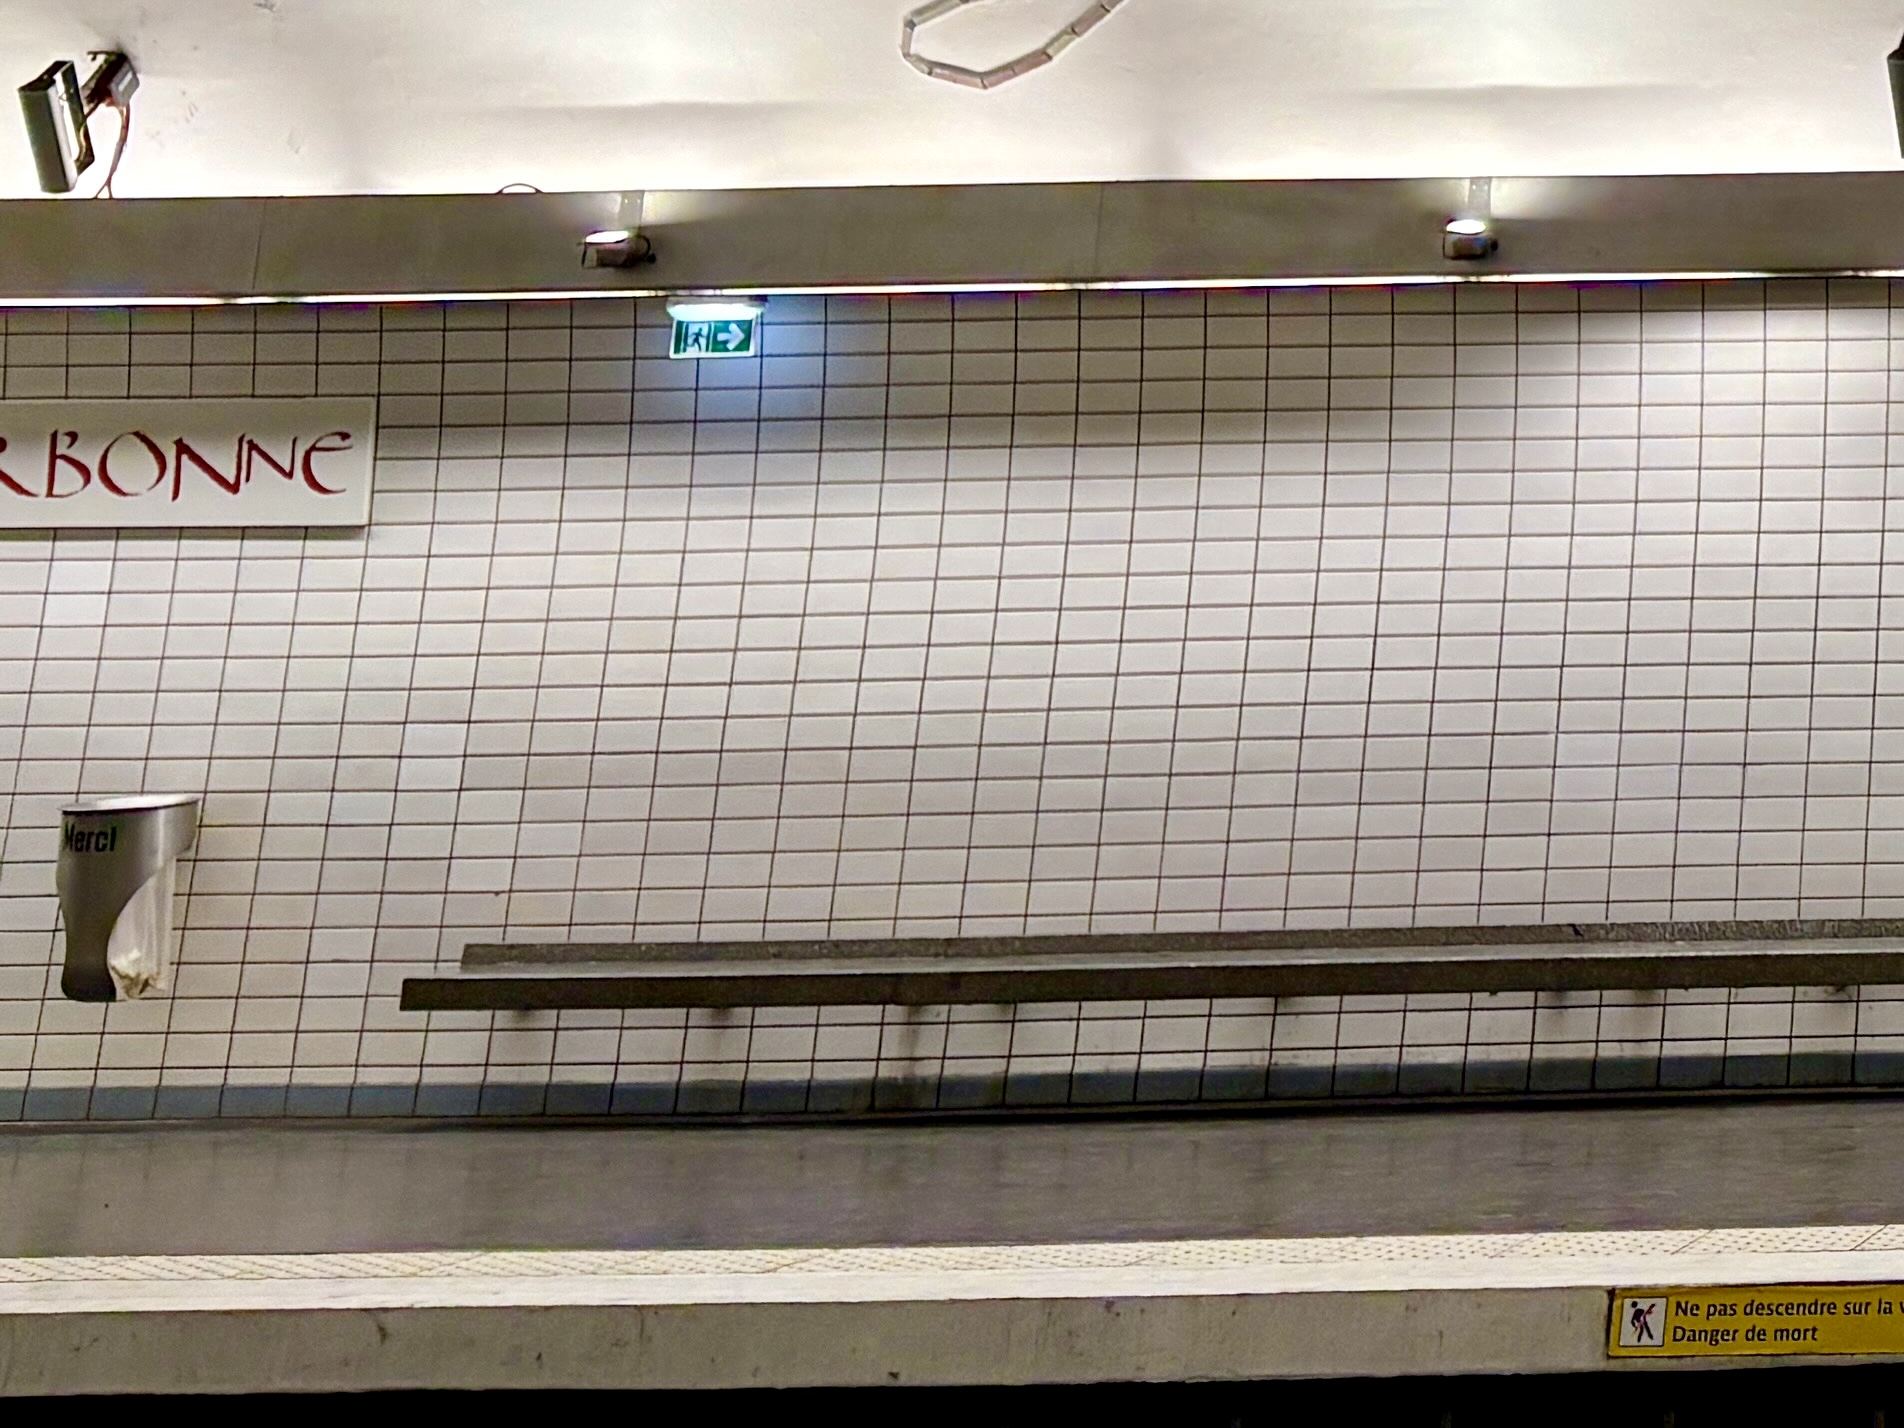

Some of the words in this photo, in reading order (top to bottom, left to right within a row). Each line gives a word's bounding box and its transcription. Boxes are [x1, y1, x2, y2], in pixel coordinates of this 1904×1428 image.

[1673, 1300, 1701, 1317] Ne
[1705, 1301, 1738, 1322] pas
[1743, 1298, 1838, 1318] descendre
[1842, 1300, 1872, 1317] sur
[1876, 1298, 1894, 1316] la
[1671, 1324, 1739, 1347] Danger
[1744, 1325, 1768, 1343] de
[1773, 1324, 1819, 1343] mort
